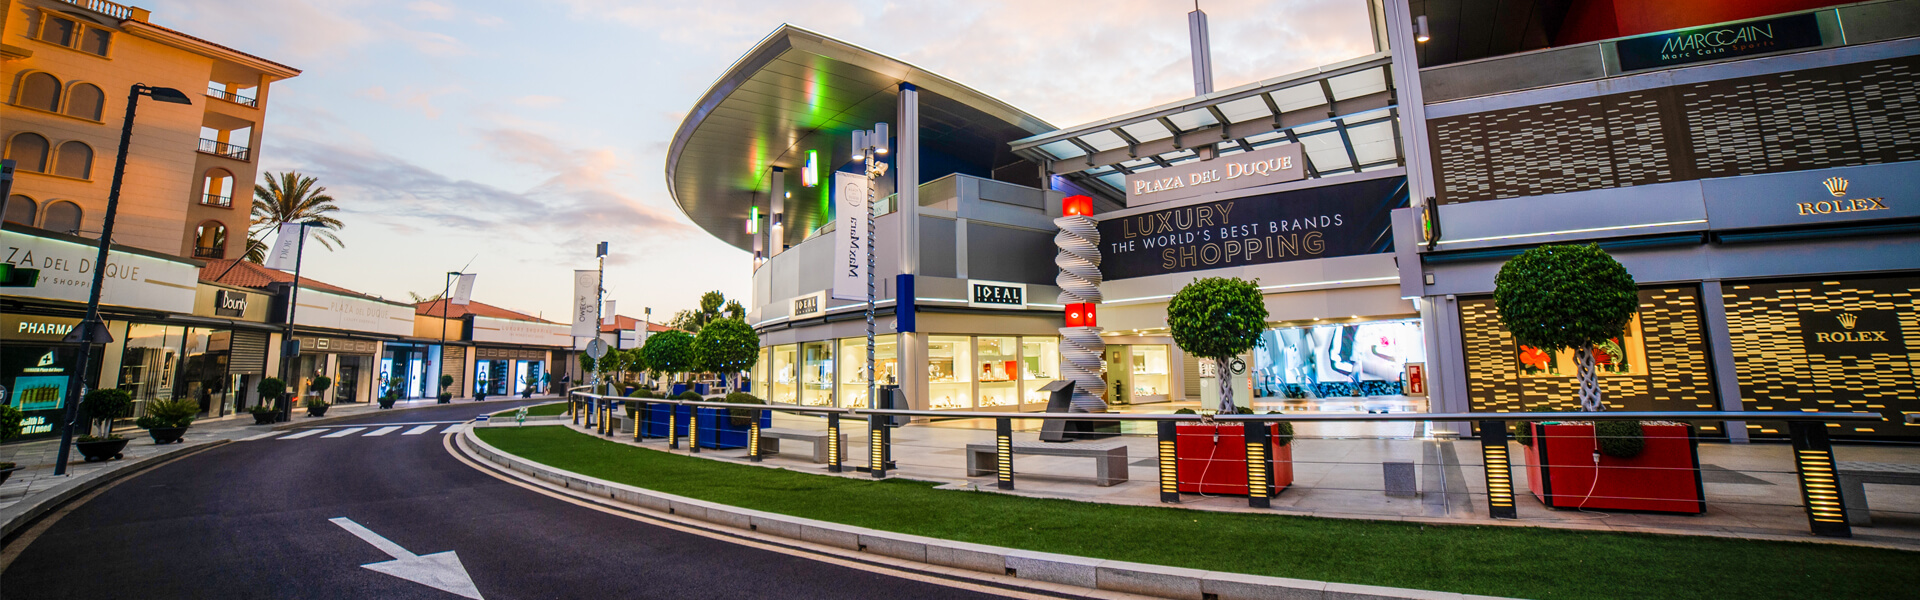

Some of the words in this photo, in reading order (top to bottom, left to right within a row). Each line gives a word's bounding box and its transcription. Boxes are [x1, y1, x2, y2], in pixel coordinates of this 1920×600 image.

[1662, 50, 1690, 60] Marc
[1697, 47, 1725, 56] Cain
[1732, 41, 1774, 51] Sports
[1133, 176, 1184, 196] PLAZA
[1189, 170, 1221, 186] DEL
[1226, 156, 1293, 180] DUQUE
[1797, 197, 1890, 215] ROLEX
[1123, 202, 1234, 239] LUXURY
[1112, 241, 1135, 254] THE
[1143, 230, 1211, 249] WORLD'S
[1221, 224, 1259, 239] BEST
[1269, 213, 1343, 233] BRANDS
[5, 246, 34, 267] ZA
[44, 256, 69, 272] DEL
[1162, 231, 1325, 269] SHOPPING
[53, 277, 90, 288] SHOPPI
[977, 286, 1019, 299] IDEAL
[223, 291, 248, 317] Bounty
[331, 302, 353, 314] PLAZA
[367, 308, 389, 319] DUQUE
[796, 298, 816, 310] IDEAL
[1815, 331, 1889, 342] ROLEX
